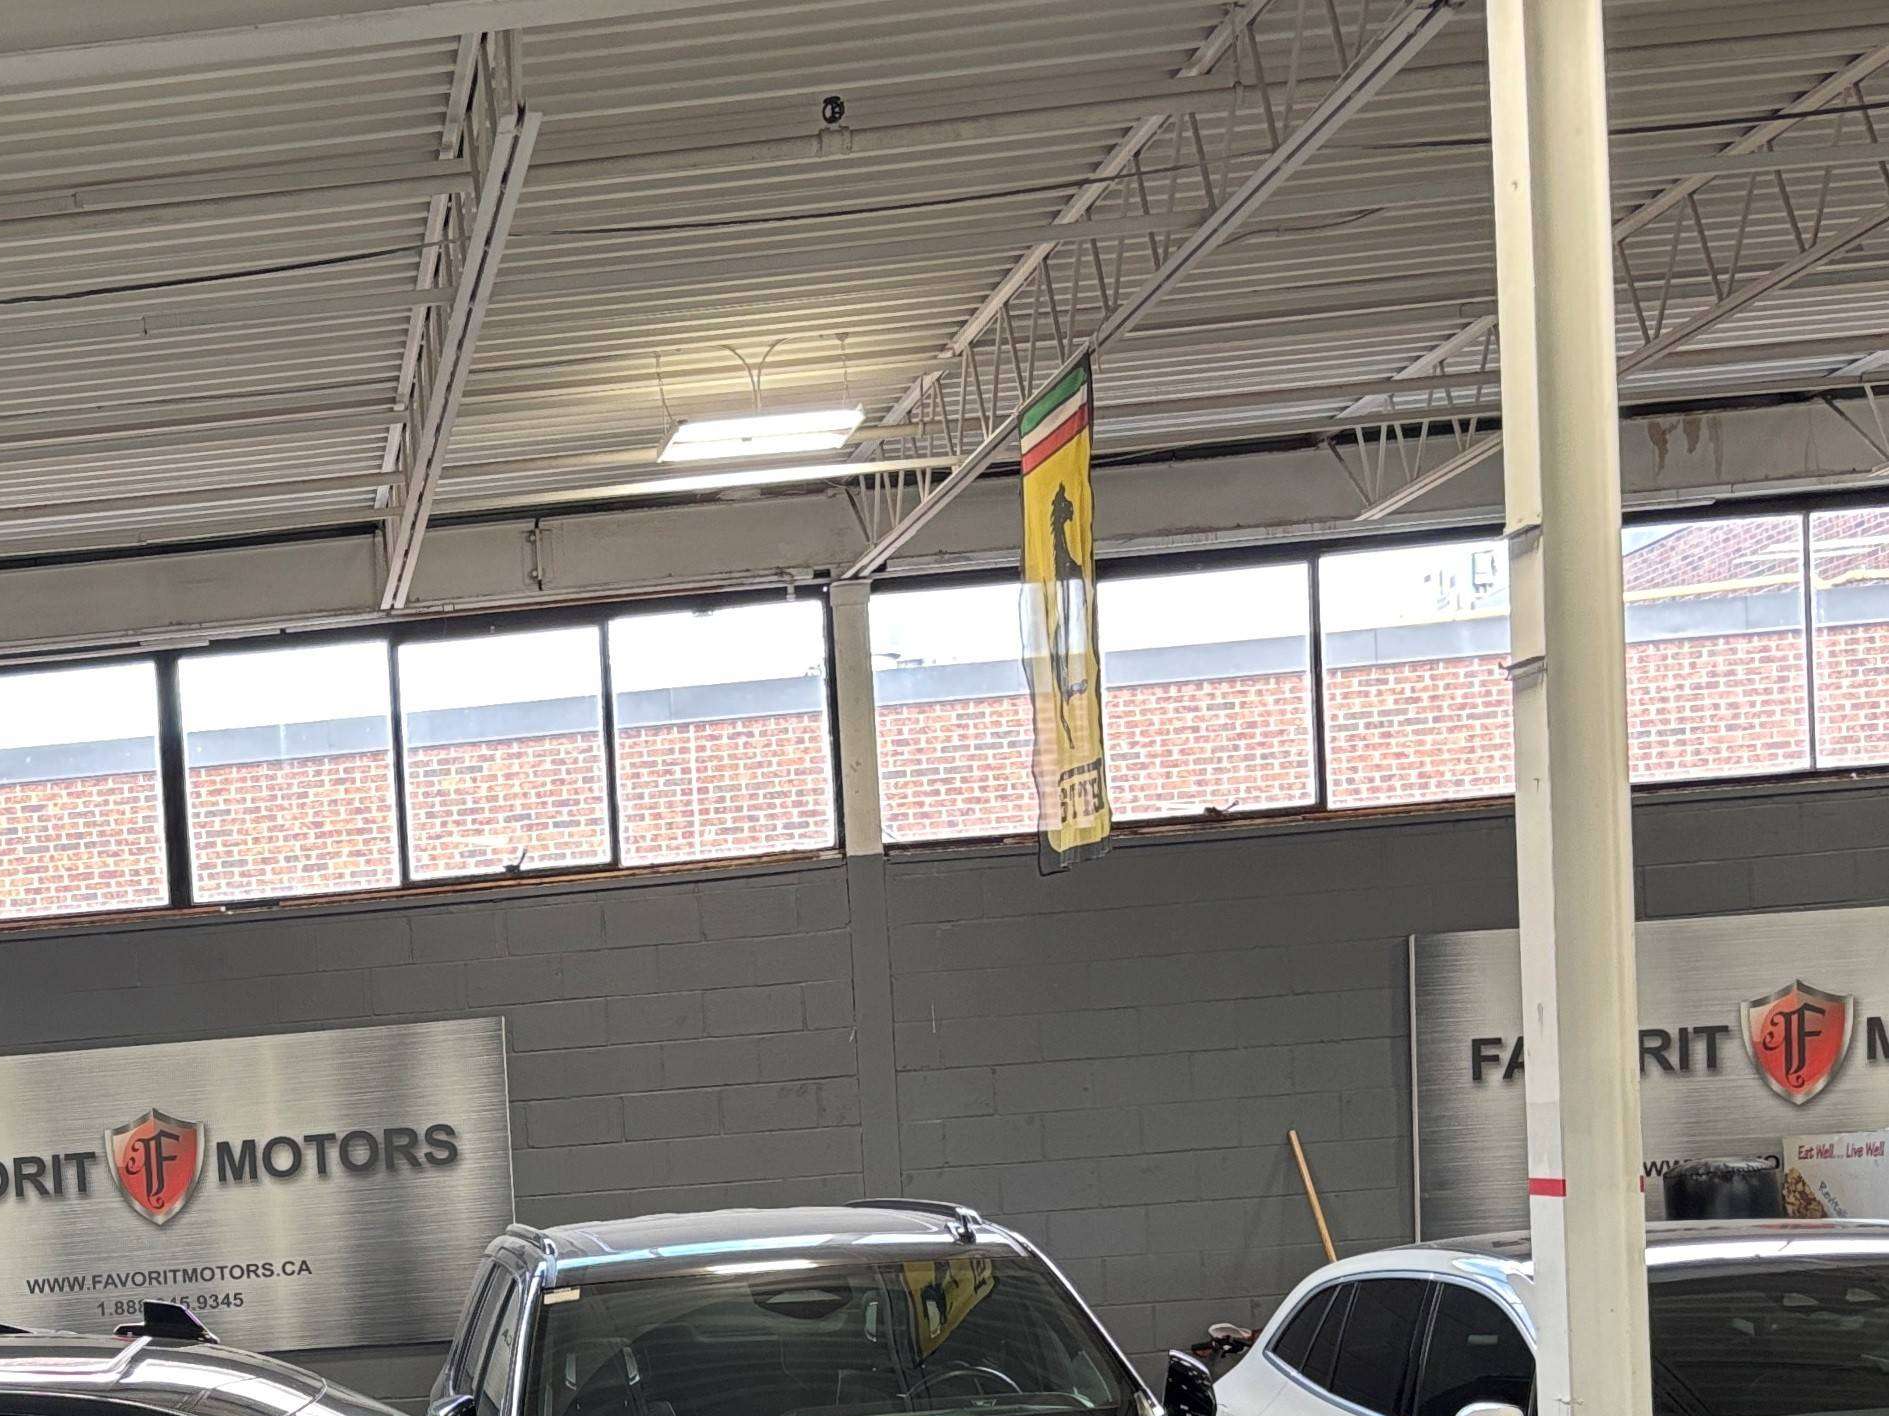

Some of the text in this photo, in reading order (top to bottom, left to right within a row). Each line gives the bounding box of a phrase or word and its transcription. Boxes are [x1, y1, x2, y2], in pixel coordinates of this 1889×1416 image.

[1471, 1023, 1730, 1082] FARIT
[216, 1122, 460, 1184] MOTORS
[1846, 1142, 1864, 1158] Live
[1865, 1140, 1886, 1157] Well
[26, 1259, 313, 1296] WWW.FAVORITMOTORS.CA
